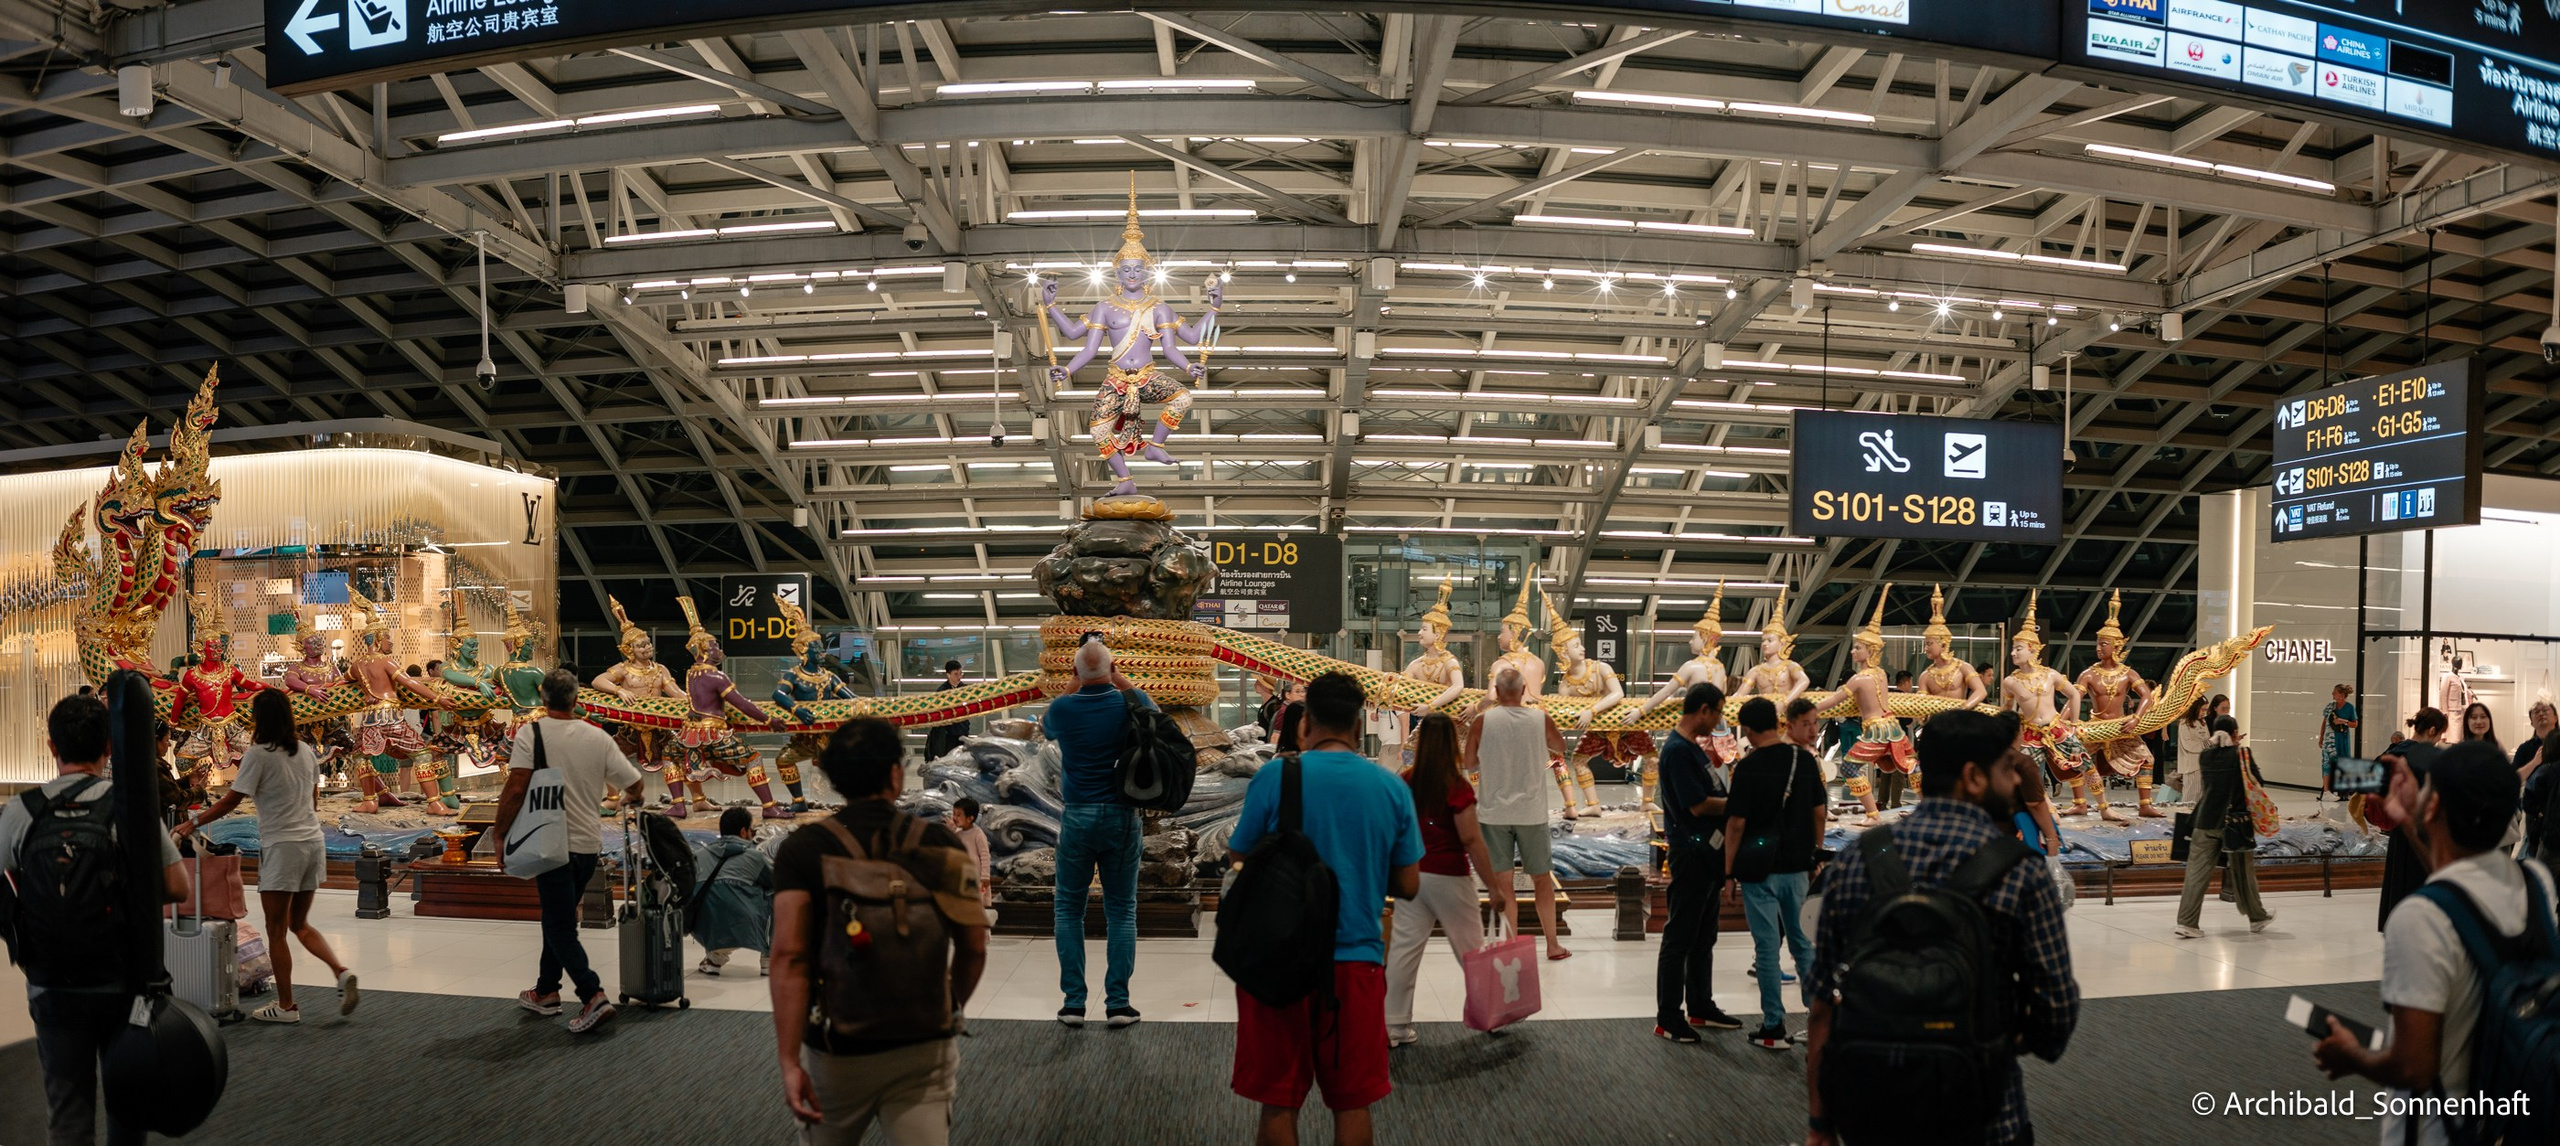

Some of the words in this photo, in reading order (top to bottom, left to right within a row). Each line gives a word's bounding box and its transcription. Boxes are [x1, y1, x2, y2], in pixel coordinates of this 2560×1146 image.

[2172, 7, 2223, 22] AIRFRANCE
[427, 5, 559, 44] 航空公司贵宾室
[2484, 13, 2508, 33] mins
[2091, 33, 2118, 44] EVA
[2120, 38, 2143, 48] AIR
[2258, 25, 2286, 37] CATHAY
[2288, 32, 2314, 43] PACIFIC
[2341, 38, 2367, 50] CHINA
[2336, 45, 2371, 60] AIRLINES
[2247, 70, 2269, 80] OMAN
[2342, 73, 2377, 88] TURKISH
[2342, 82, 2377, 96] AIRLINES
[2404, 103, 2434, 116] MIRACLE
[2307, 394, 2346, 421] D6-D8
[2379, 376, 2427, 407] E1-E10
[2306, 425, 2343, 451] F1-F6
[2377, 410, 2422, 438] G1-G5
[2306, 460, 2370, 490] S101-S128
[1812, 490, 1976, 526] S101-S128
[2020, 510, 2030, 519] Up
[2030, 511, 2038, 519] to
[2291, 508, 2302, 518] VAT
[2020, 520, 2029, 528] 15
[2029, 520, 2046, 529] mins
[1219, 579, 1243, 587] Airline
[1244, 579, 1276, 589] Lounges
[2265, 640, 2335, 662] CHANEL
